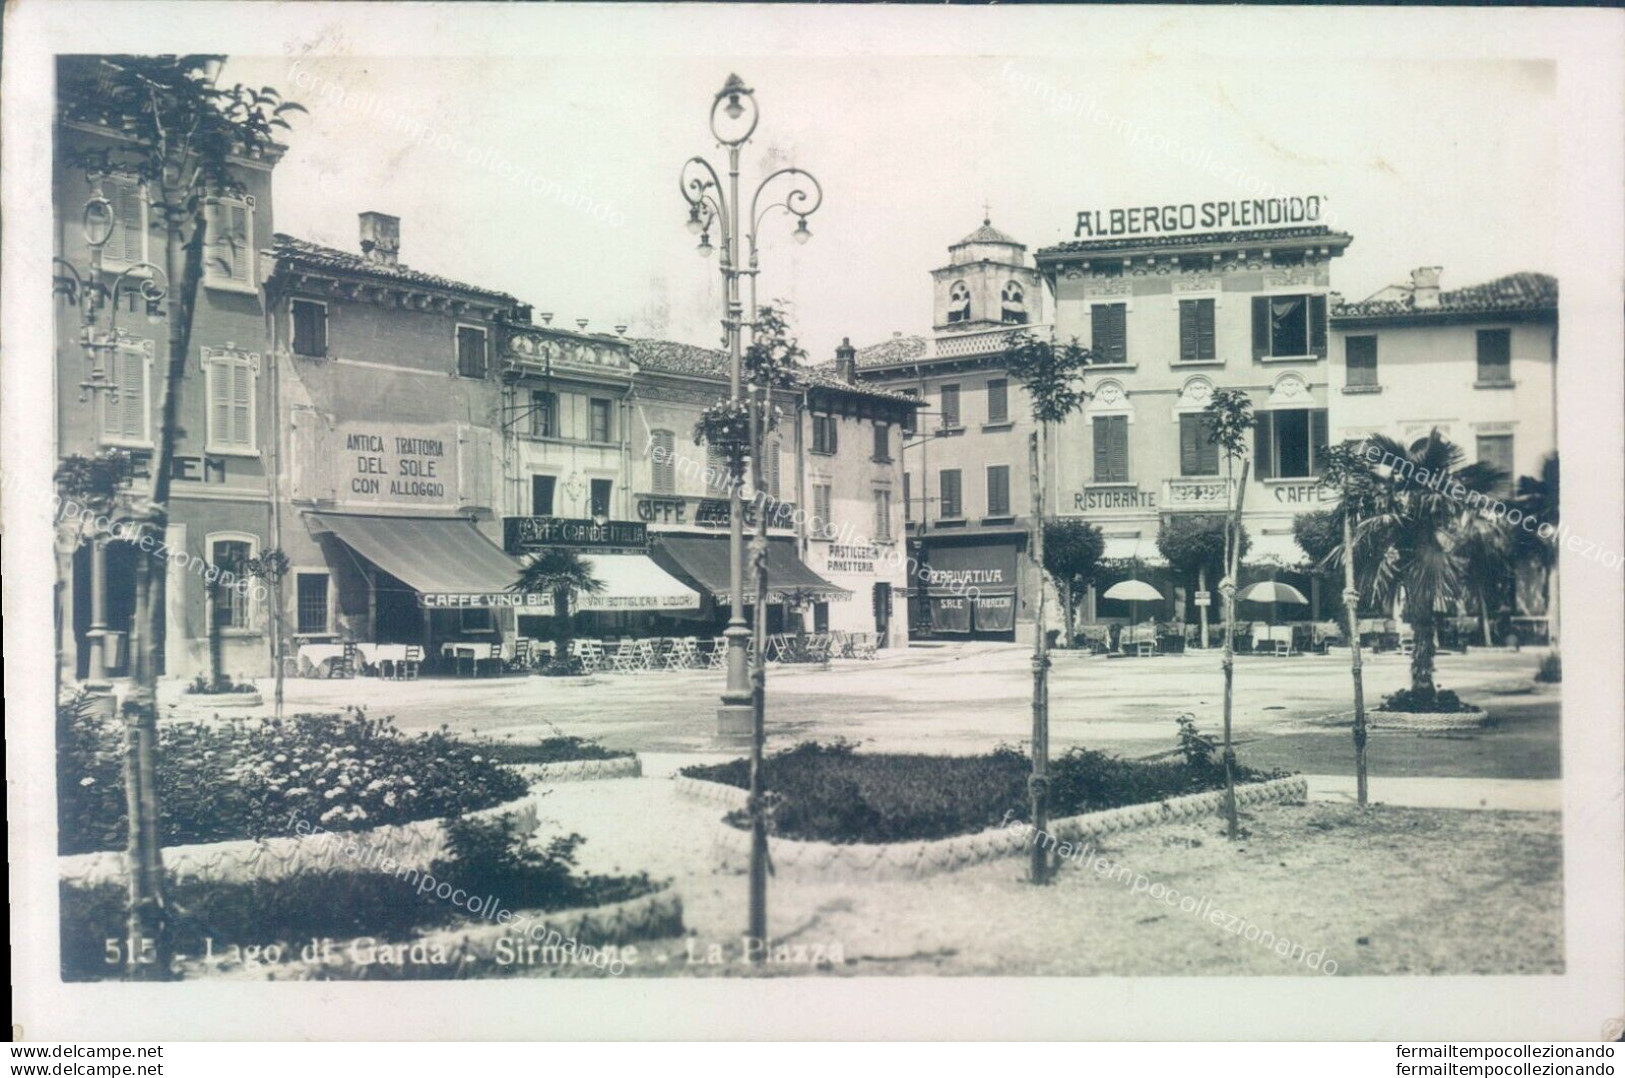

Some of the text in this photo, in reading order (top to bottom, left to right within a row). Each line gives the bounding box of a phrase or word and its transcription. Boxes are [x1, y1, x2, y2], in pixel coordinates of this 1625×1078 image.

[1074, 195, 1320, 237] ALBERGO SPLENDIDO
[347, 433, 443, 457] ANTICA TRATTORIA
[358, 456, 437, 478] DEL SOLE
[351, 477, 444, 497] CON ALLOGGIO
[1275, 486, 1327, 503] CAFFE
[1074, 490, 1157, 511] RISTORANTE
[562, 523, 609, 542] GRANDE
[610, 525, 644, 543] ITALIA
[827, 560, 874, 573] PANETTERIA
[423, 592, 556, 607] CAFFE VINO BIR
[940, 599, 963, 610] SALE
